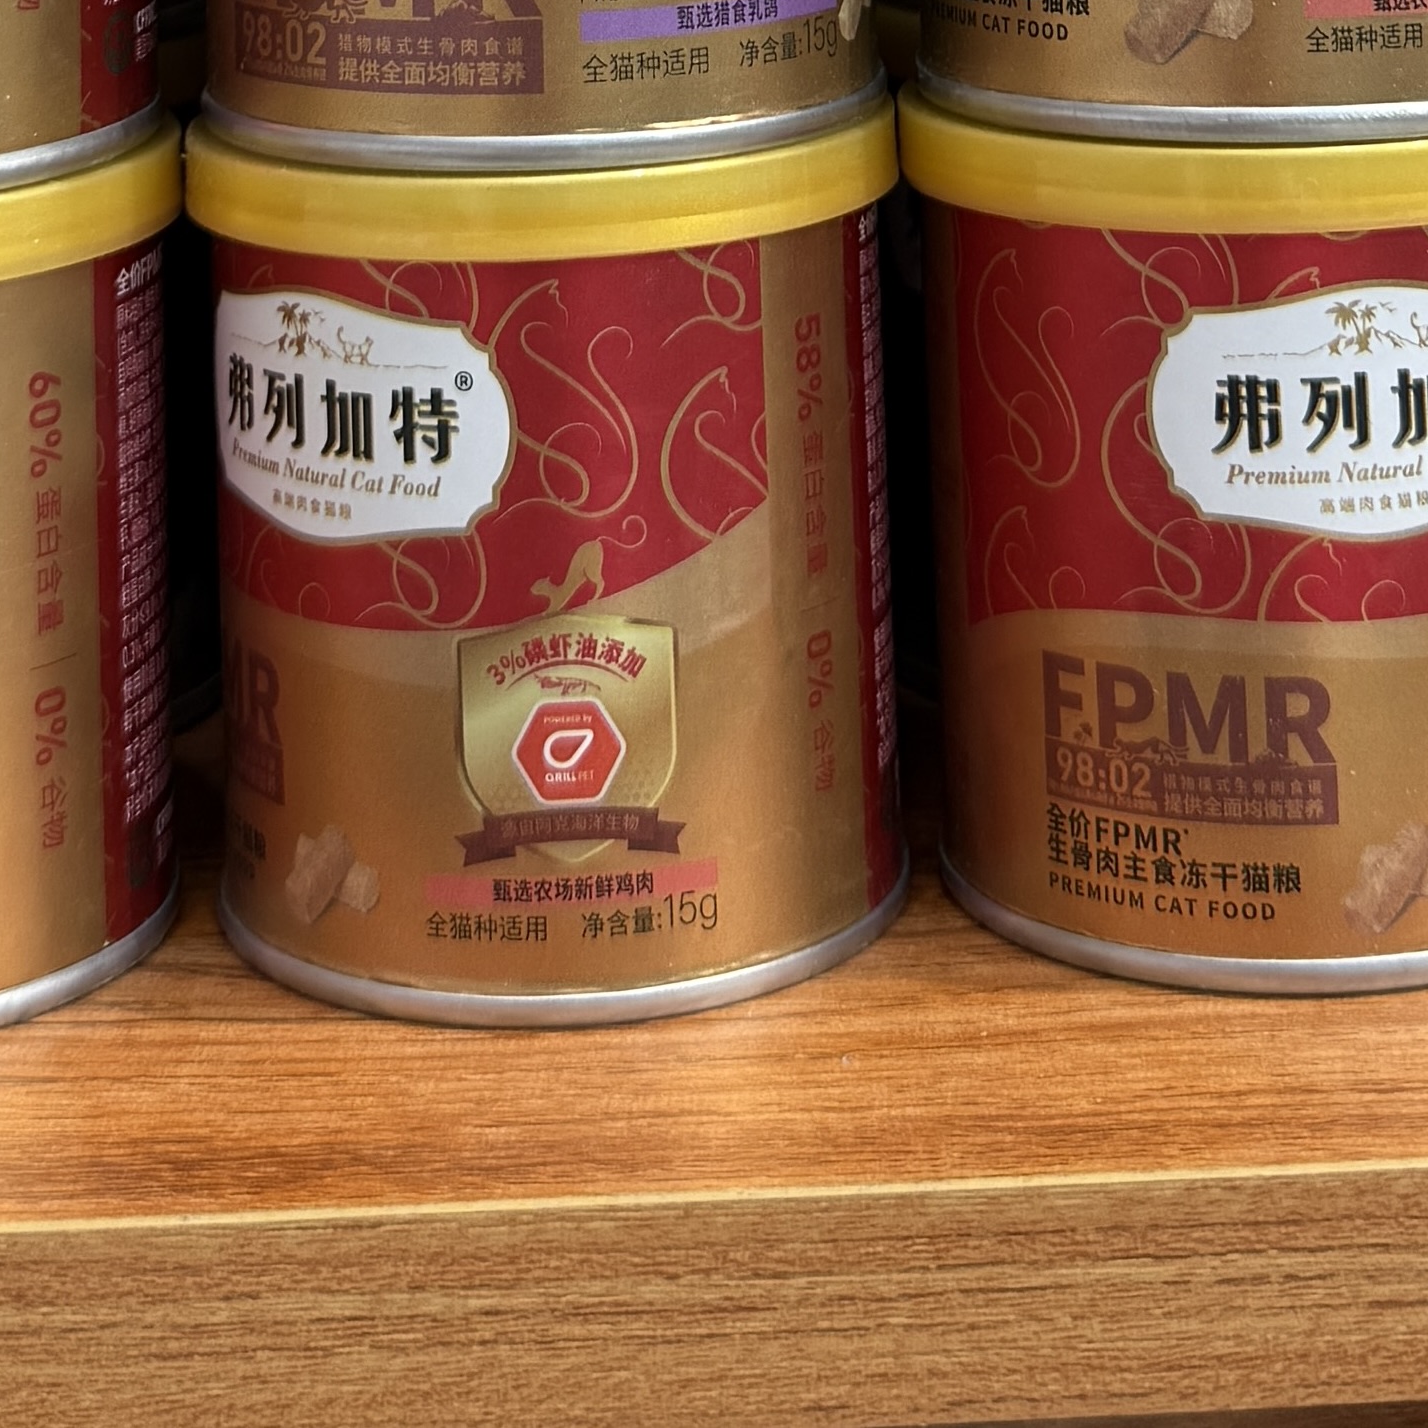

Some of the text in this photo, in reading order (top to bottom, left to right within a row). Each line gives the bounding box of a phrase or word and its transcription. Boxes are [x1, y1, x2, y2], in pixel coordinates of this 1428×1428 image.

[982, 11, 1068, 41] CAT FOOD
[1306, 24, 1423, 54] 全猫种适用
[338, 56, 525, 87] 提供全面均衡营养
[581, 47, 709, 83] 全猫种适用
[796, 312, 825, 421] 58%
[227, 352, 459, 465] 弗列加特
[28, 371, 65, 637] 60% 蛋白含量
[1042, 648, 1337, 767] FPMR
[33, 686, 66, 850] 0% 谷物
[1055, 746, 1151, 796] 98:02
[1046, 801, 1184, 856] 全价FPMR
[493, 869, 654, 904] 甄选农场新鲜鸡肉
[1047, 837, 1302, 895] 生骨肉主食冻干猫粮
[426, 889, 719, 943] 全猫种适用 净含量:15g
[1049, 871, 1276, 922] PREMIUM CAT FOOD
